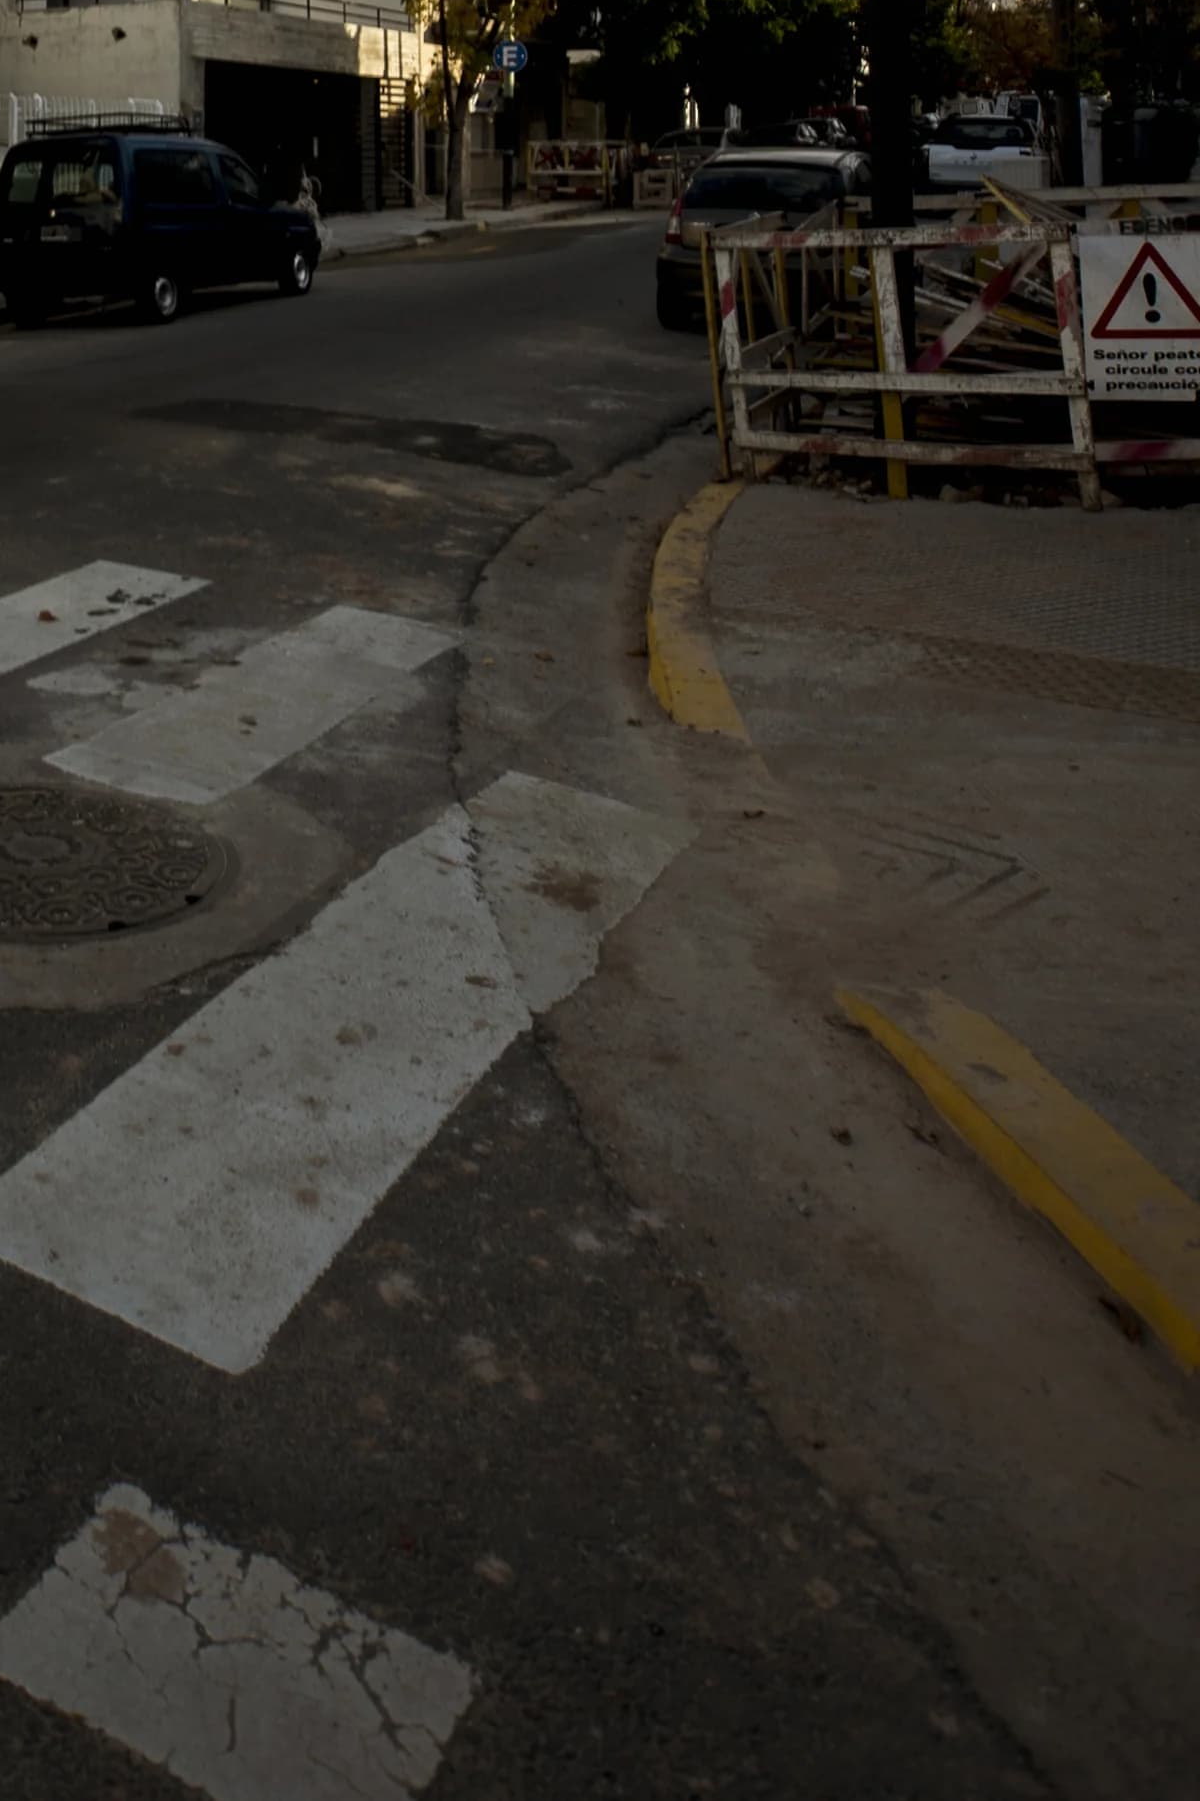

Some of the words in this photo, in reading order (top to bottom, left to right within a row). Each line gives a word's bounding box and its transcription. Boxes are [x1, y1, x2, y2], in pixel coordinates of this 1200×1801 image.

[502, 46, 518, 67] E
[1093, 349, 1148, 360] Señor
[1105, 364, 1168, 374] circule
[1174, 366, 1200, 374] co
